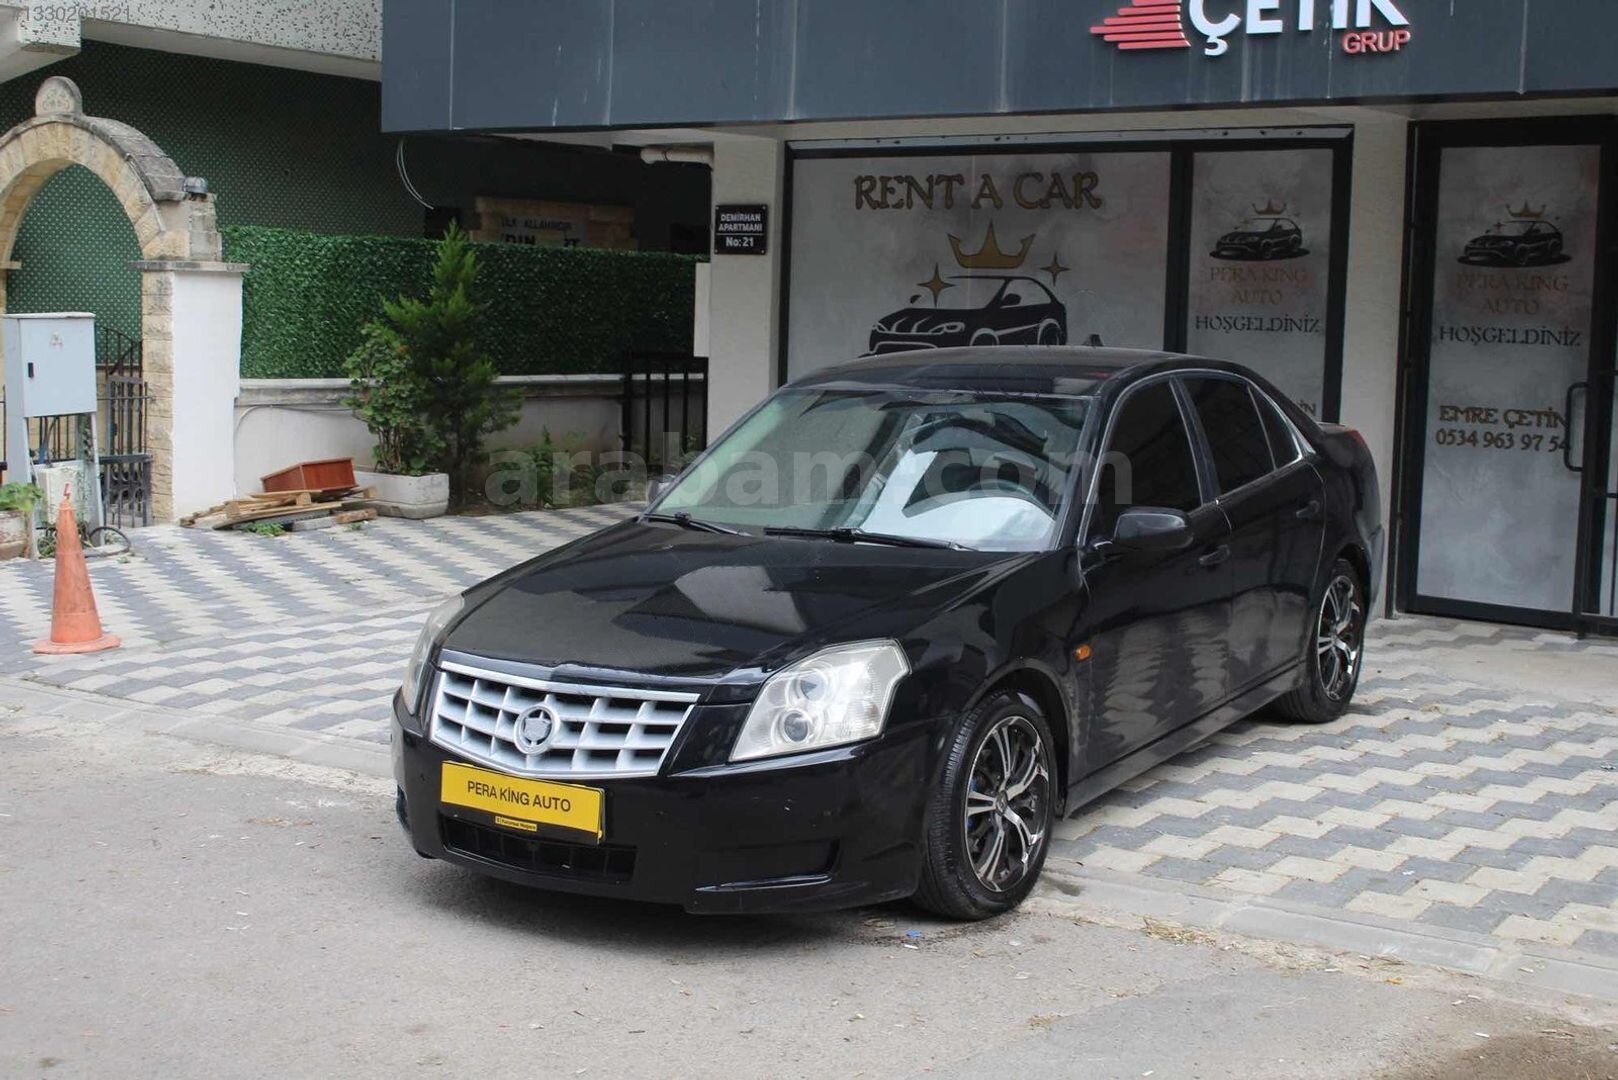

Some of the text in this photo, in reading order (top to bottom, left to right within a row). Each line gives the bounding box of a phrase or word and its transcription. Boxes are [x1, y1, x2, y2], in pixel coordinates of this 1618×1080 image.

[1342, 30, 1411, 54] GRUP
[854, 172, 1102, 210] RENT A CAR
[718, 223, 763, 232] APARTMANI
[1210, 266, 1257, 281] PERA
[1456, 271, 1511, 289] PERA
[1231, 288, 1283, 305] AUTO
[1484, 298, 1540, 315] AUTO
[1195, 313, 1321, 334] HOŞGELDİNİZ
[1439, 325, 1582, 346] HOŞGELDİNİZ
[1439, 405, 1499, 425] EMRE
[1435, 427, 1479, 447] 0534
[1483, 431, 1514, 449] 963
[1521, 433, 1544, 450] 97
[467, 780, 572, 812] PERA KİNG AUTO
